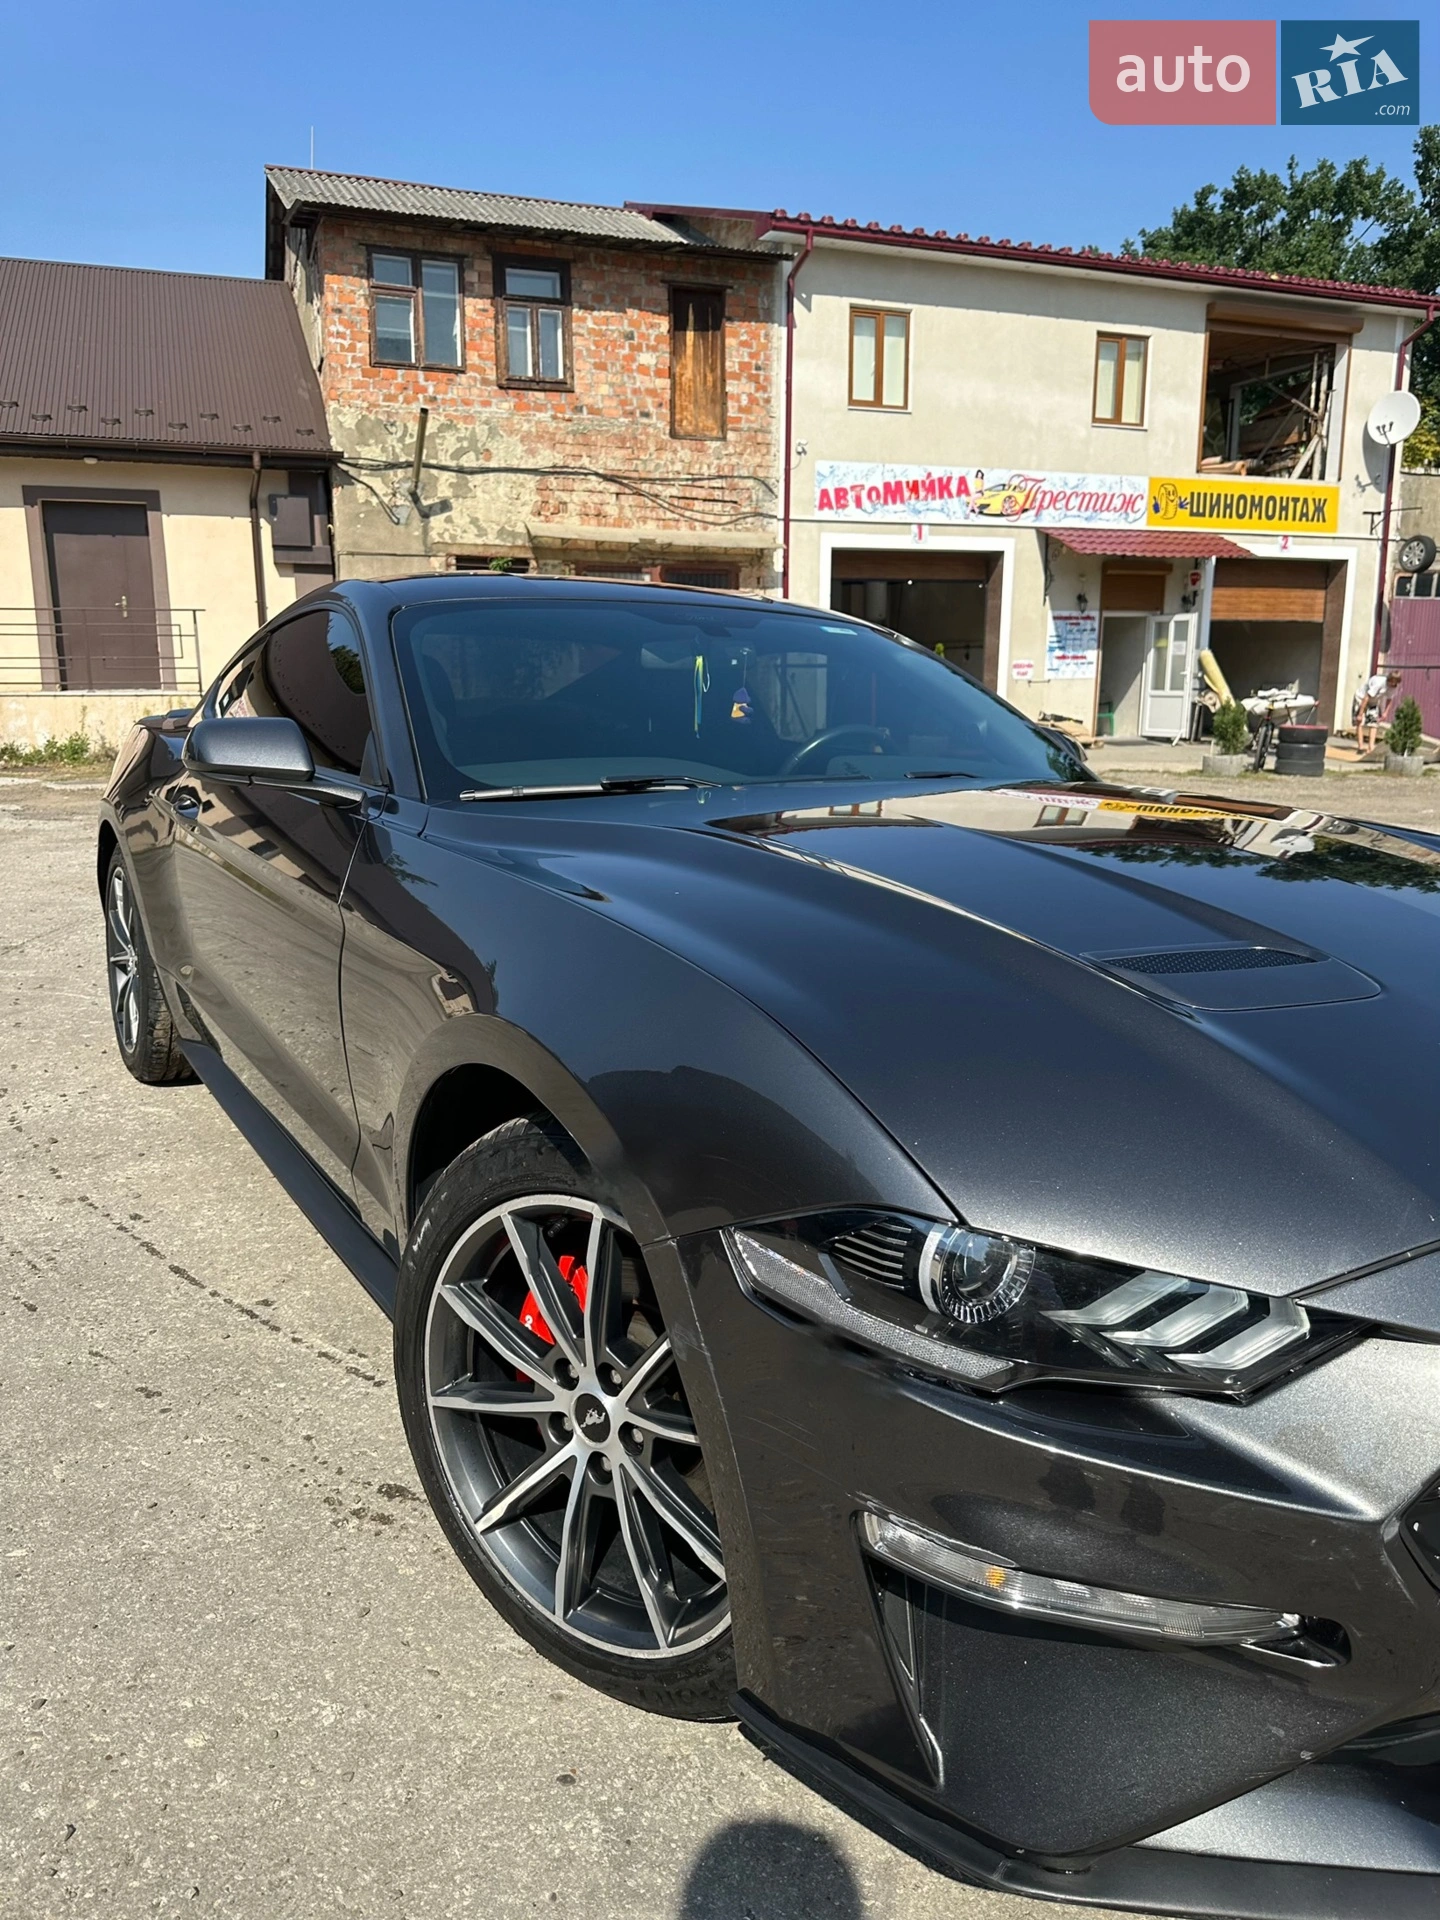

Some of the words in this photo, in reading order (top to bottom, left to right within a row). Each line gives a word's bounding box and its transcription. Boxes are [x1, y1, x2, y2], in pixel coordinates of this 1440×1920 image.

[1003, 474, 1144, 522] Престиж
[1189, 491, 1328, 523] ШИНОМОНТАЖ
[916, 524, 923, 540] 1
[1281, 535, 1289, 550] 2
